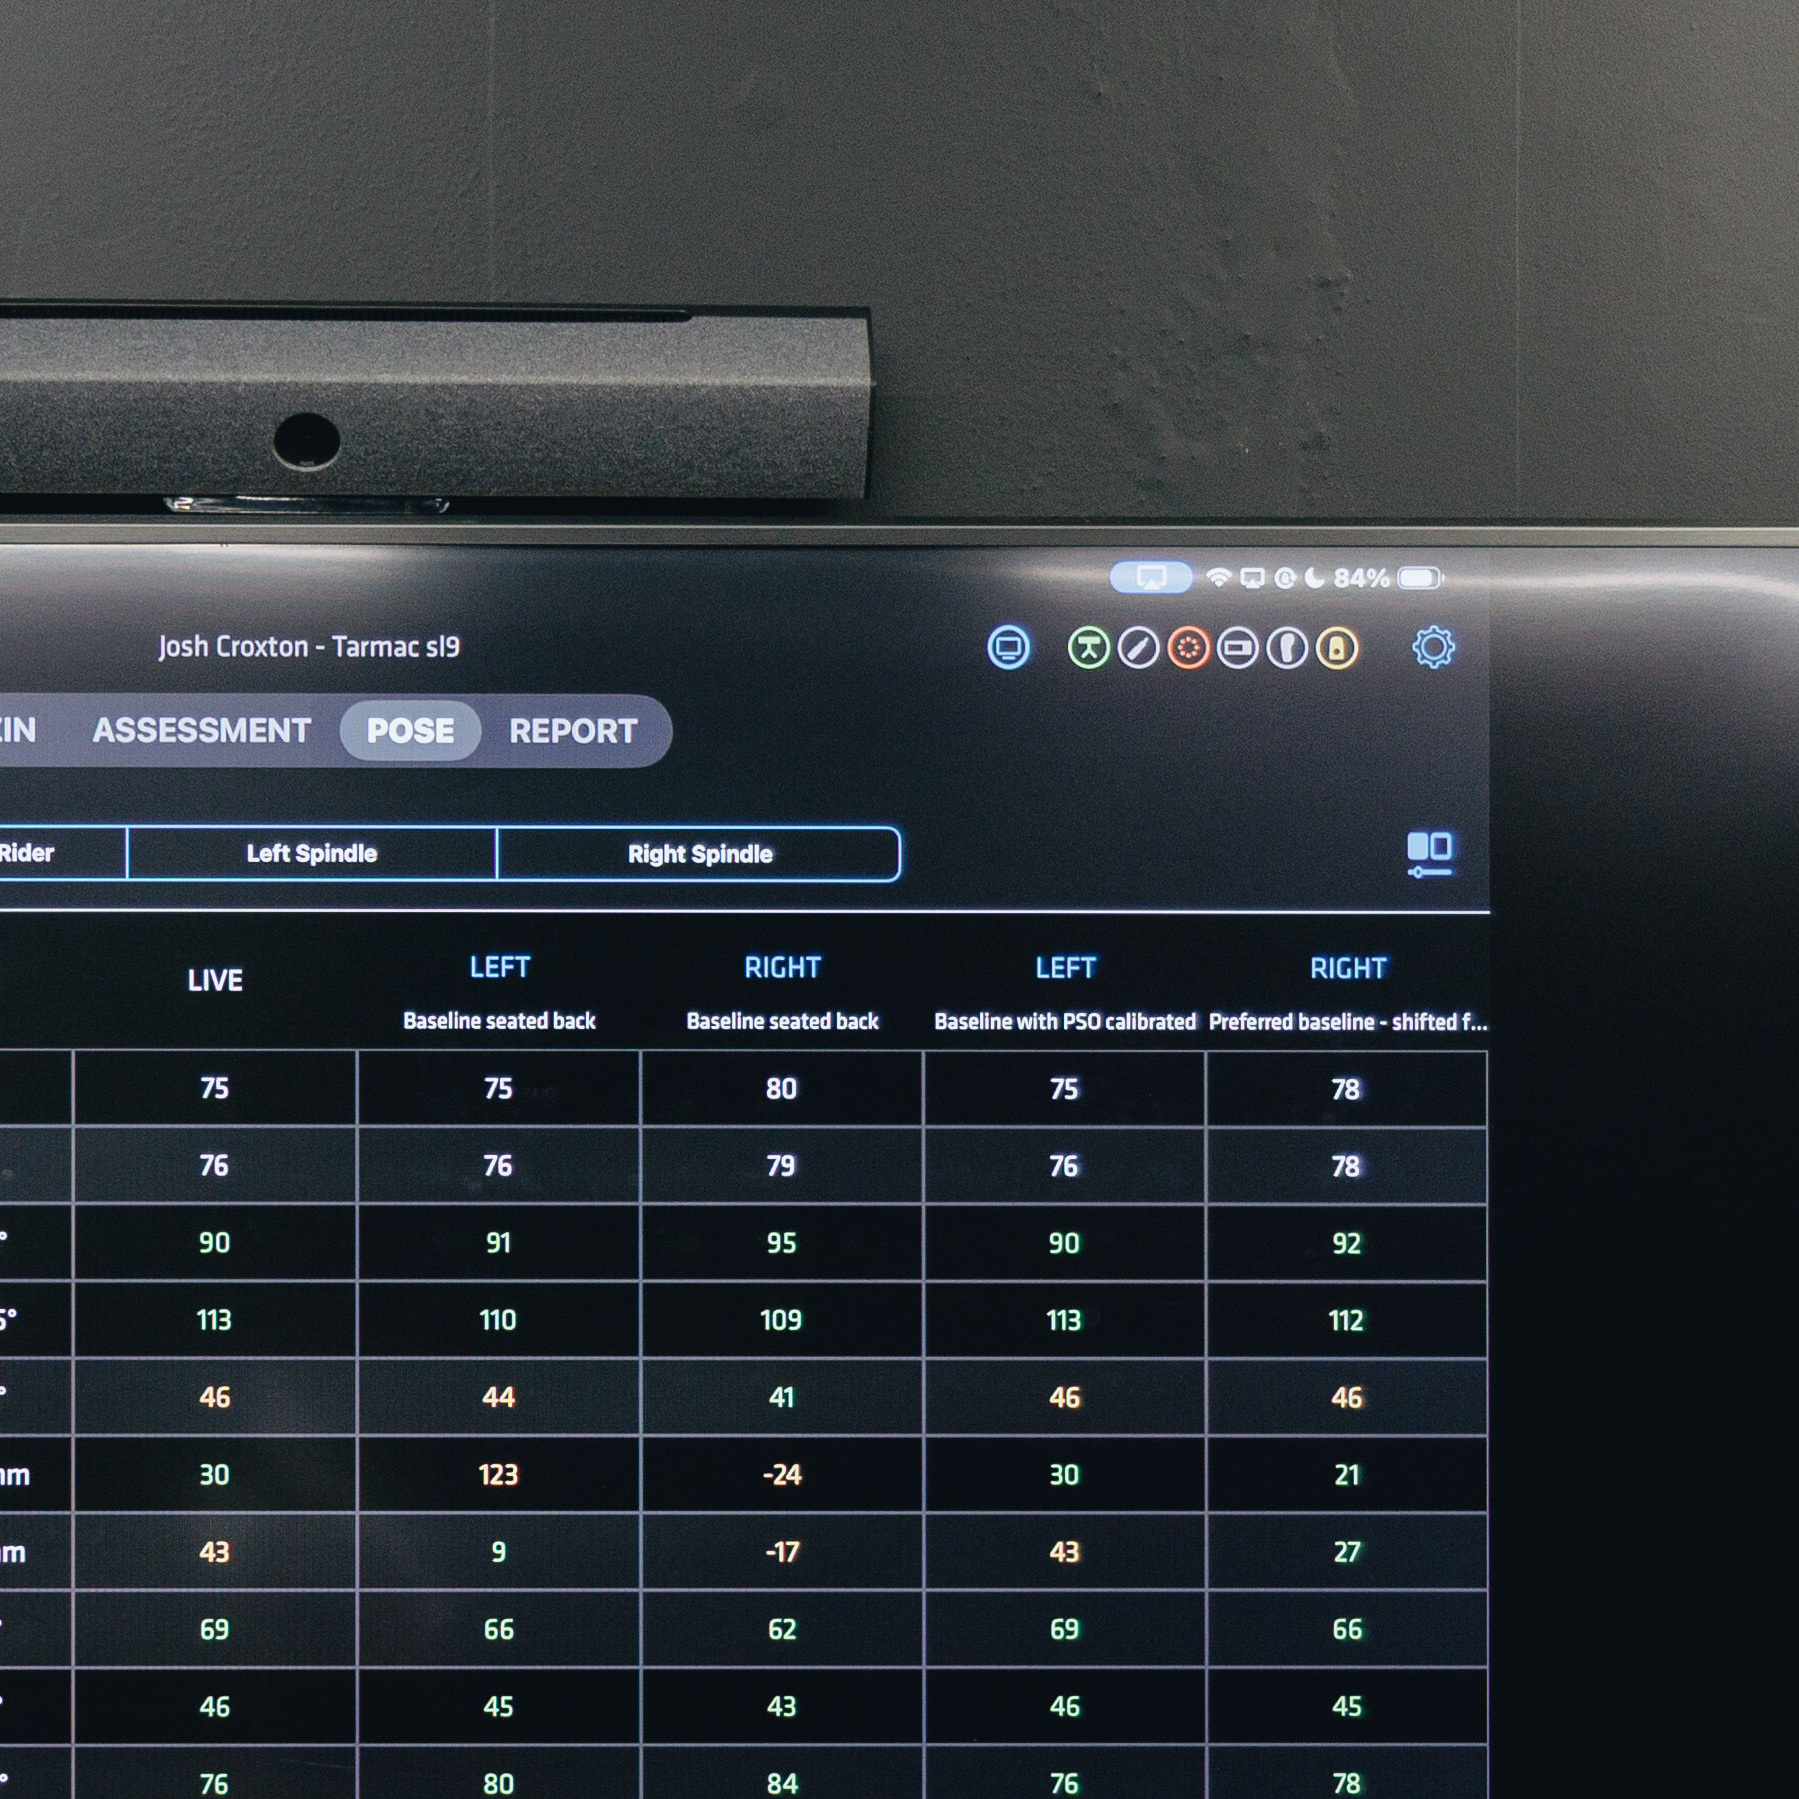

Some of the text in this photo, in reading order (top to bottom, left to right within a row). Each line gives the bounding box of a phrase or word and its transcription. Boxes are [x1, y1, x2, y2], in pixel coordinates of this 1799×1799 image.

[1334, 567, 1391, 589] 84%
[157, 633, 209, 662] Josh
[216, 634, 309, 658] Croxton
[331, 634, 420, 658] Tarmac
[426, 634, 461, 658] sl9
[92, 716, 313, 744] ASSESSMENT
[365, 714, 455, 745] POSE
[510, 717, 639, 744] REPORT
[247, 842, 378, 867] Left Spindle
[628, 843, 774, 868] Right Spindle
[470, 955, 532, 979] LEFT
[745, 955, 823, 979] RIGHT
[1036, 955, 1098, 979] LEFT
[1311, 956, 1389, 980] RIGHT
[188, 968, 243, 992] LIVE
[403, 1010, 597, 1030] Baseline seated back
[686, 1011, 880, 1031] Baseline seated back
[934, 1011, 1197, 1031] Baseline with PSO calibrated
[1209, 1011, 1294, 1031] Preferred
[1298, 1011, 1376, 1031] baseline
[1392, 1011, 1458, 1032] shifted
[200, 1076, 229, 1099] 75
[484, 1077, 513, 1100] 75
[766, 1077, 797, 1100] 80
[1049, 1077, 1079, 1100] 75
[1331, 1078, 1360, 1101] 78
[196, 1308, 232, 1331] 113
[479, 1308, 517, 1331] 110
[760, 1308, 802, 1331] 109
[1046, 1309, 1082, 1331] 113
[1328, 1309, 1364, 1332] 112
[200, 1463, 230, 1486] 30
[478, 1463, 519, 1486] 123
[763, 1463, 803, 1486] -24
[1050, 1463, 1079, 1486] 30
[1335, 1463, 1359, 1486] 21
[200, 1773, 229, 1795] 76
[483, 1772, 514, 1795] 80
[767, 1772, 799, 1795] 84
[1050, 1772, 1079, 1795] 76
[1333, 1772, 1361, 1795] 78
